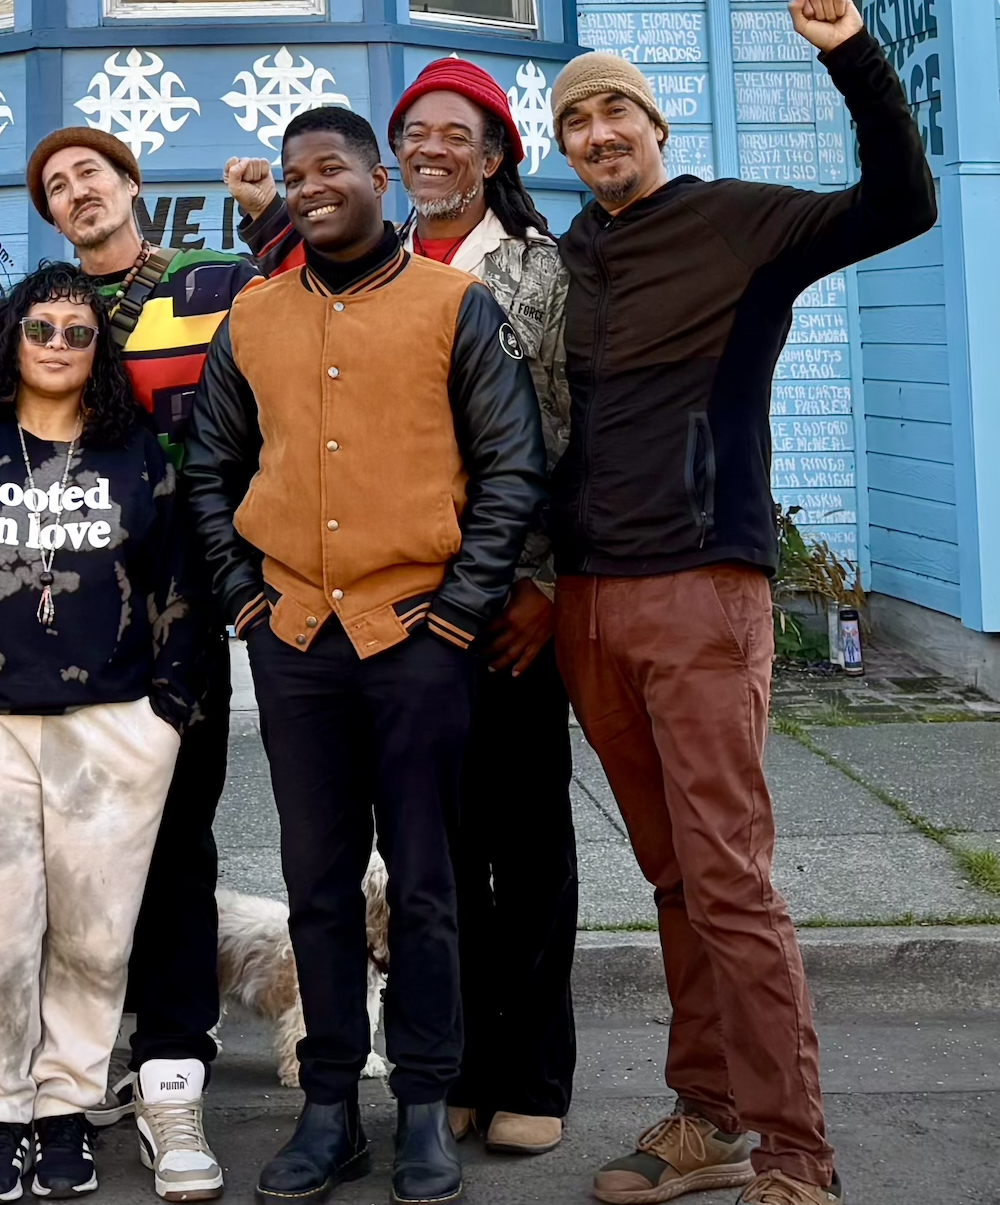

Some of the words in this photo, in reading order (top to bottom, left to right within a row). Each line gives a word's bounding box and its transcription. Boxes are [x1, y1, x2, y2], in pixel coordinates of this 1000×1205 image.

[644, 46, 701, 61] MEADORS
[779, 106, 834, 122] GIBSON
[740, 149, 781, 163] ROSITA
[785, 149, 843, 163] THOMAS
[800, 314, 843, 327] SMITH
[25, 512, 111, 550] love
[160, 1081, 185, 1091] PUMA
